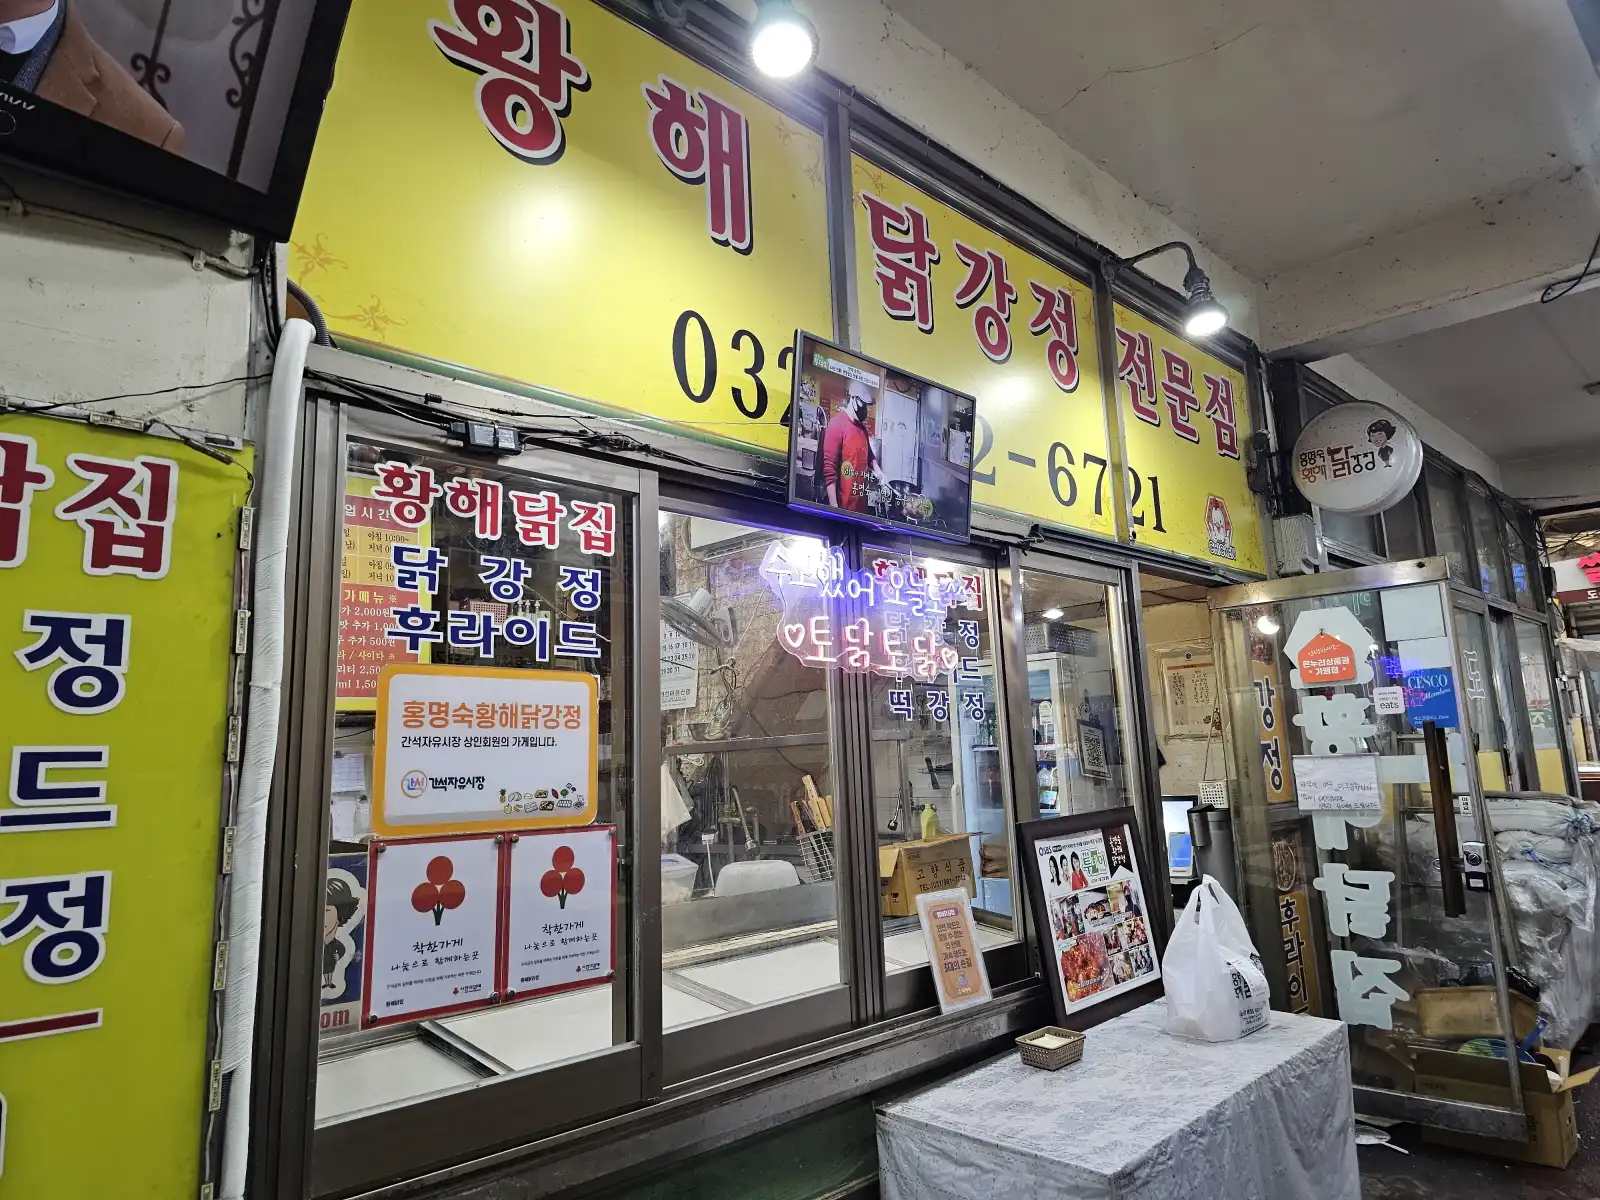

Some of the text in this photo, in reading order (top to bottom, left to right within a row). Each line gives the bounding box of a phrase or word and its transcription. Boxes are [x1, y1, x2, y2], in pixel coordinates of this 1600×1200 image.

[859, 189, 1079, 394] 닭강정
[1115, 327, 1241, 460] 전문점
[1300, 449, 1326, 468] 홍명숙
[1301, 464, 1328, 484] 황해
[0, 433, 179, 580] 집
[371, 460, 616, 557] 황해닭집
[367, 531, 382, 542] 아침
[368, 542, 383, 553] 저녁
[368, 560, 383, 570] 아침
[368, 572, 383, 582] 저녁
[352, 620, 371, 631] 추가
[384, 603, 601, 663] 후라이드
[348, 636, 366, 646] 추가
[358, 651, 384, 662] 사이다
[1302, 656, 1350, 669] 온누리상품권
[1314, 666, 1340, 675] 가맹점
[1408, 673, 1448, 690] CESCO
[1380, 701, 1399, 710] eats
[401, 700, 582, 730] 홍명숙황해닭강정
[401, 736, 558, 749] 간석자유시장 상인회원의 가게입니다.
[428, 775, 486, 792] 간석자유시장
[541, 920, 584, 936] 착한가게
[413, 937, 464, 955] 착한가게
